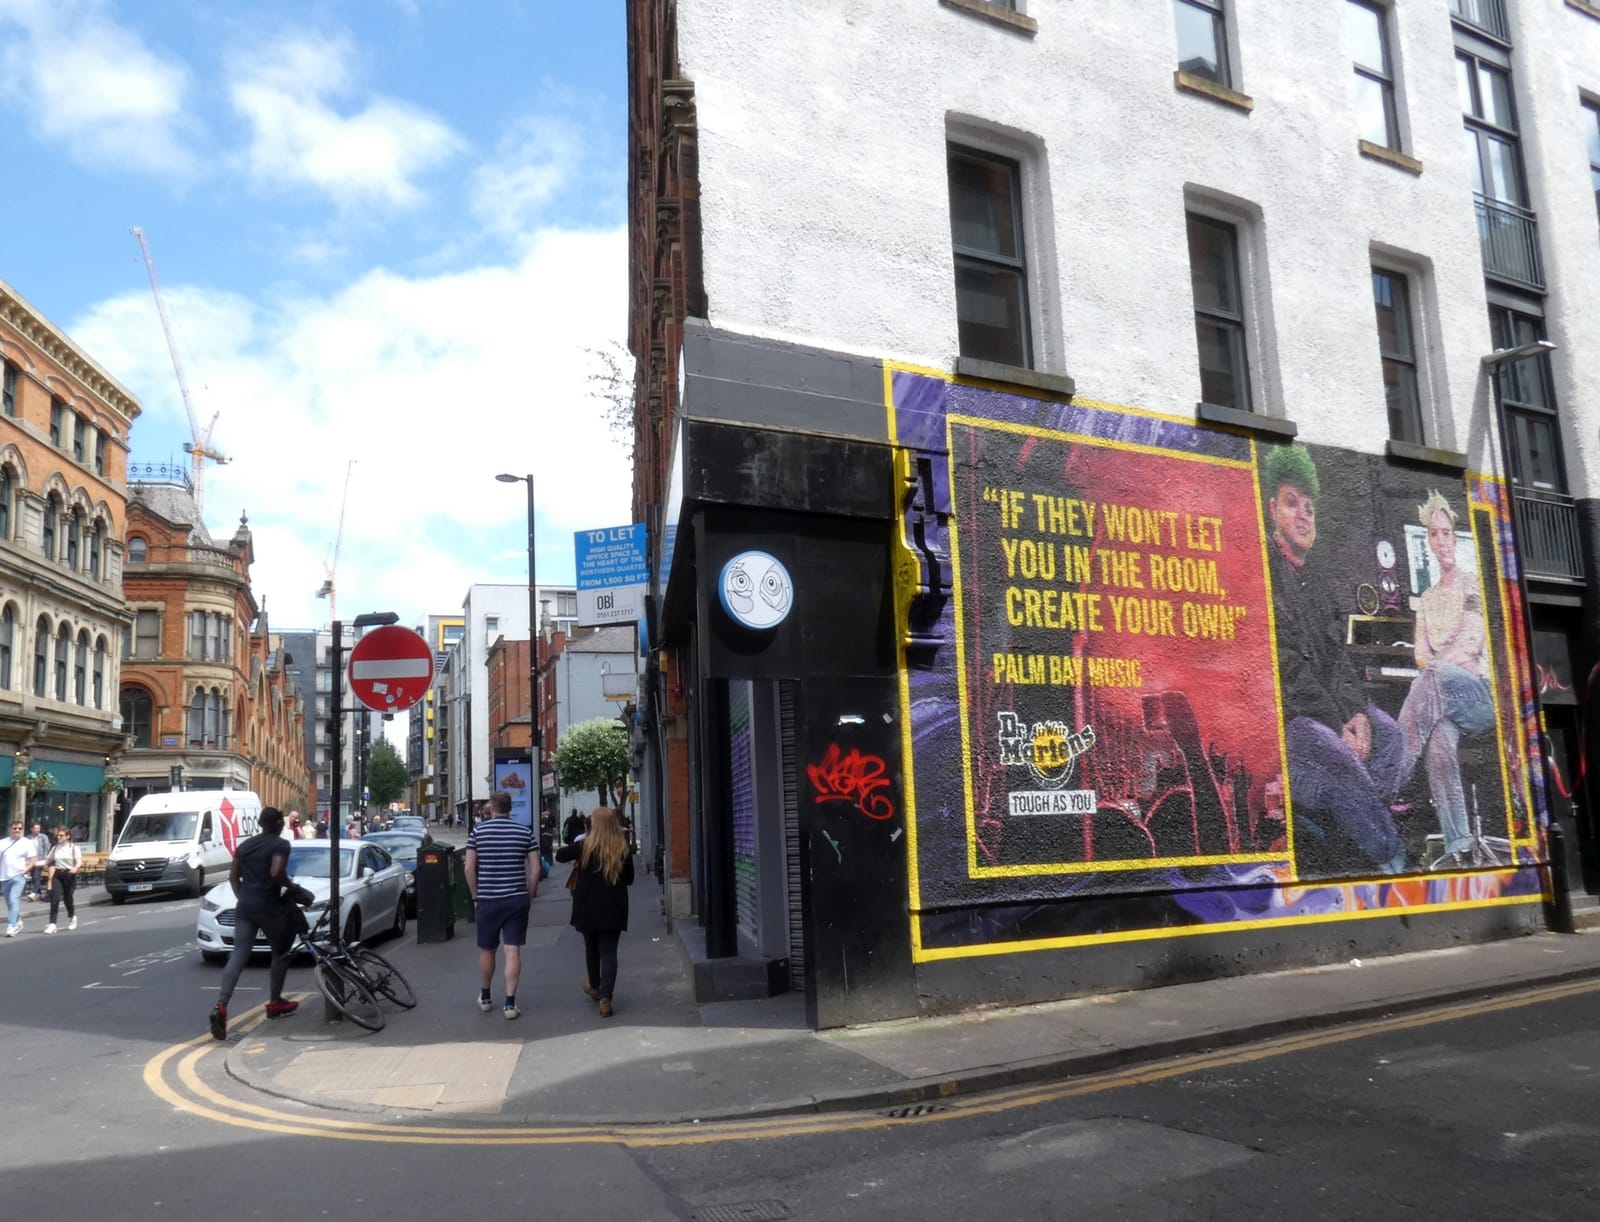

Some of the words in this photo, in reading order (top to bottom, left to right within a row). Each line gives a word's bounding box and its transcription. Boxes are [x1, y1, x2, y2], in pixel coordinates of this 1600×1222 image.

[1032, 494, 1096, 538] THEY
[1185, 514, 1222, 552] LET
[587, 531, 605, 544] TO
[610, 527, 635, 541] LET
[586, 553, 609, 561] OFFICE
[610, 550, 630, 558] SPACE
[607, 542, 634, 552] QUALITY
[580, 568, 615, 576] NORTHERN
[1001, 538, 1056, 581] YOU
[1064, 545, 1091, 583] IN
[1097, 549, 1144, 589] THE
[1149, 554, 1227, 600] ROOM,
[581, 578, 601, 587] FROM
[603, 576, 623, 585] 1,500
[1005, 586, 1103, 633] CREATE
[1107, 595, 1176, 637] YOUR
[993, 653, 1045, 684] PALM
[1049, 655, 1083, 686] BAY
[1088, 657, 1143, 688] MUSIC
[1000, 725, 1096, 765] Martens
[1012, 795, 1050, 813] TOUGH
[1053, 796, 1067, 811] AS
[1071, 793, 1092, 811] YOU
